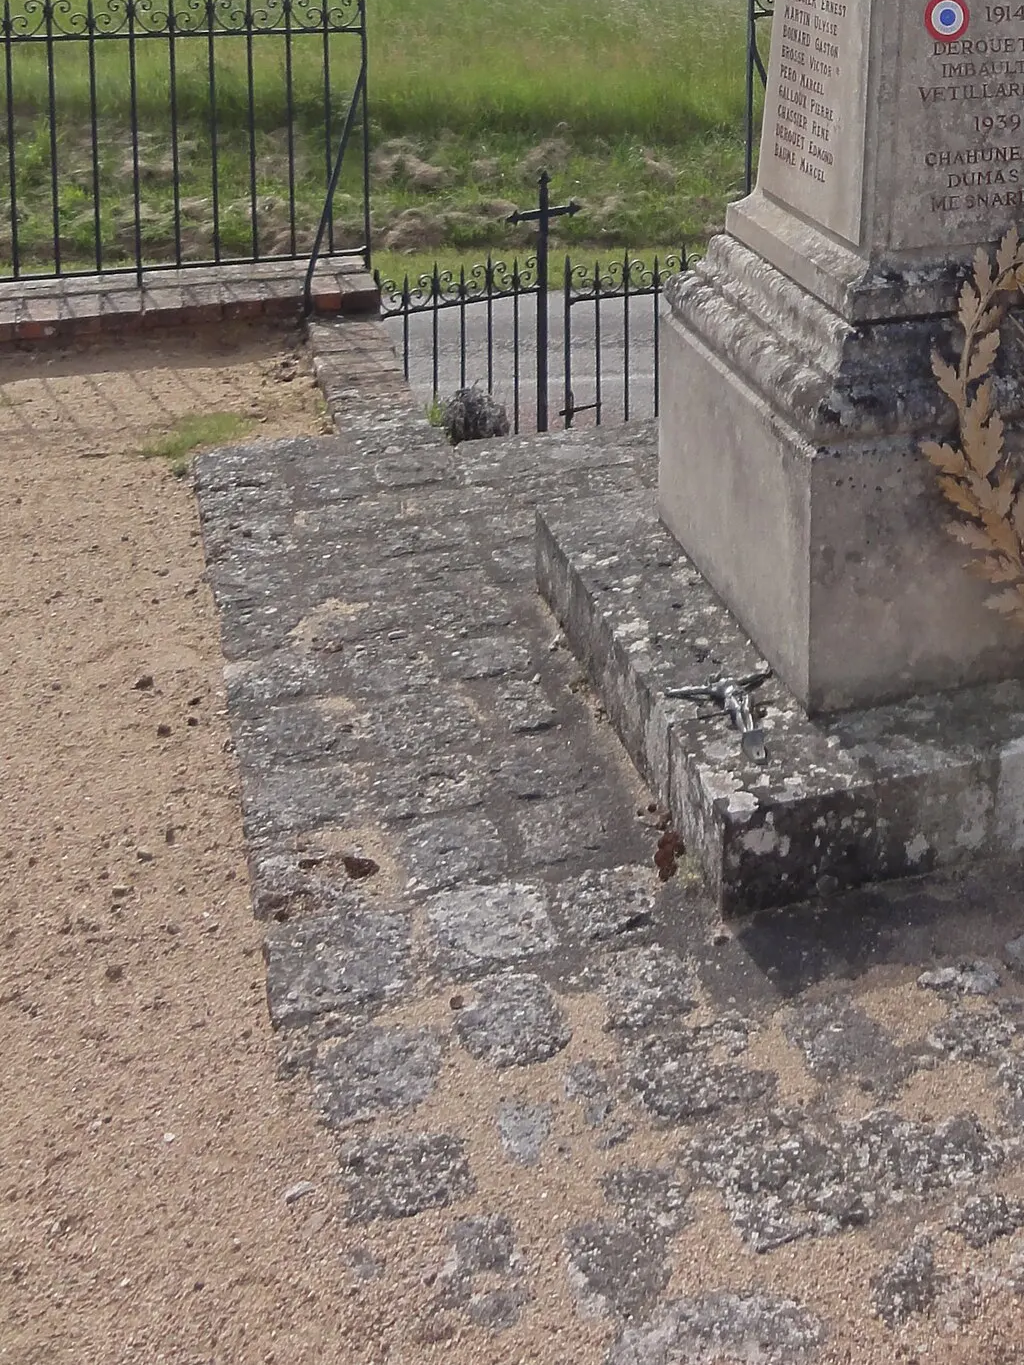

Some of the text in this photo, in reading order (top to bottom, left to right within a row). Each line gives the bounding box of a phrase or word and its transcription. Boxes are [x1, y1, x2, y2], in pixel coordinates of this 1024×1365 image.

[784, 5, 838, 36] MARTIN ULYSSE
[814, 37, 839, 58] GASTON
[809, 55, 832, 77] VICTOR
[799, 73, 825, 95] MARCEL
[777, 104, 808, 130] CHASSIER
[810, 98, 834, 121] PIERRE
[974, 114, 1021, 133] 1939
[775, 123, 834, 165] DEROUET EDMOND
[799, 157, 826, 183] MARCEL
[947, 169, 1019, 188] DUMAS
